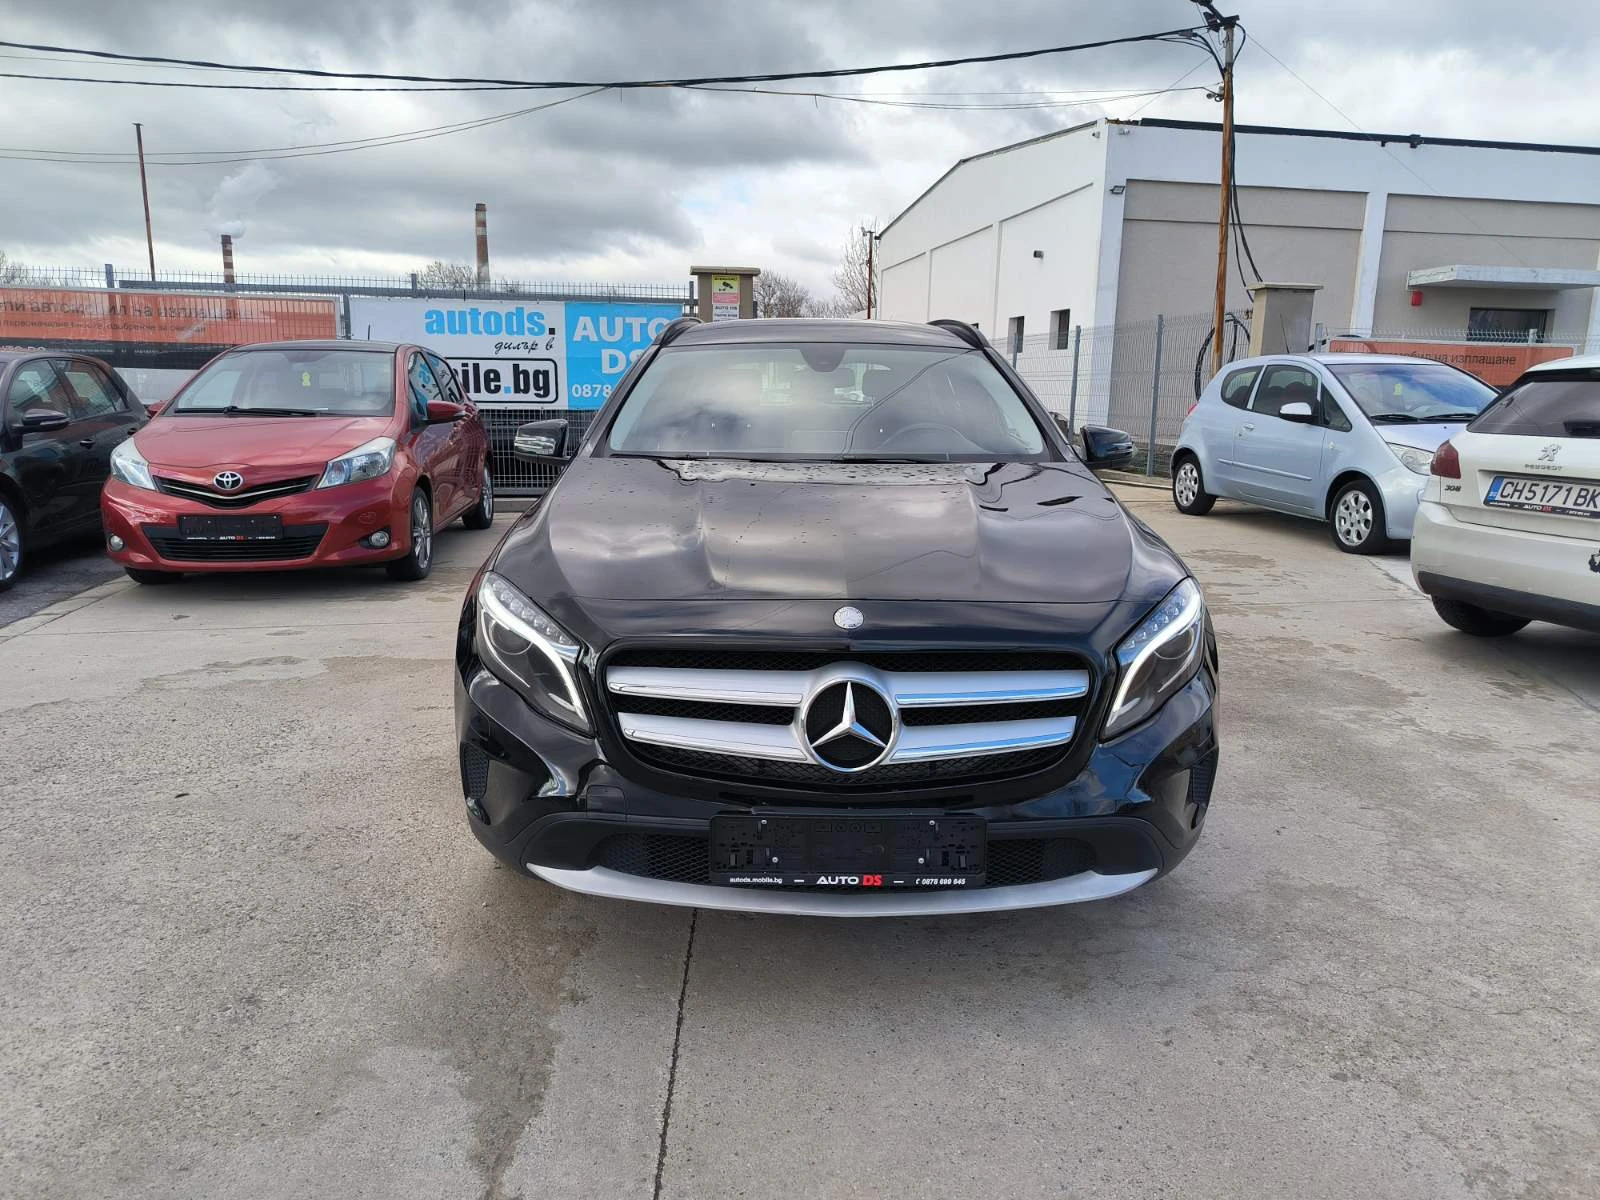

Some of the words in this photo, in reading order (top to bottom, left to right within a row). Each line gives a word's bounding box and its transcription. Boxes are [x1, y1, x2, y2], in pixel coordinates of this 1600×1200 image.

[425, 306, 556, 336] autods.
[454, 362, 551, 399] ile.bg
[1525, 463, 1563, 472] PEUGEOT
[816, 875, 860, 885] AUTO
[862, 874, 882, 886] DS
